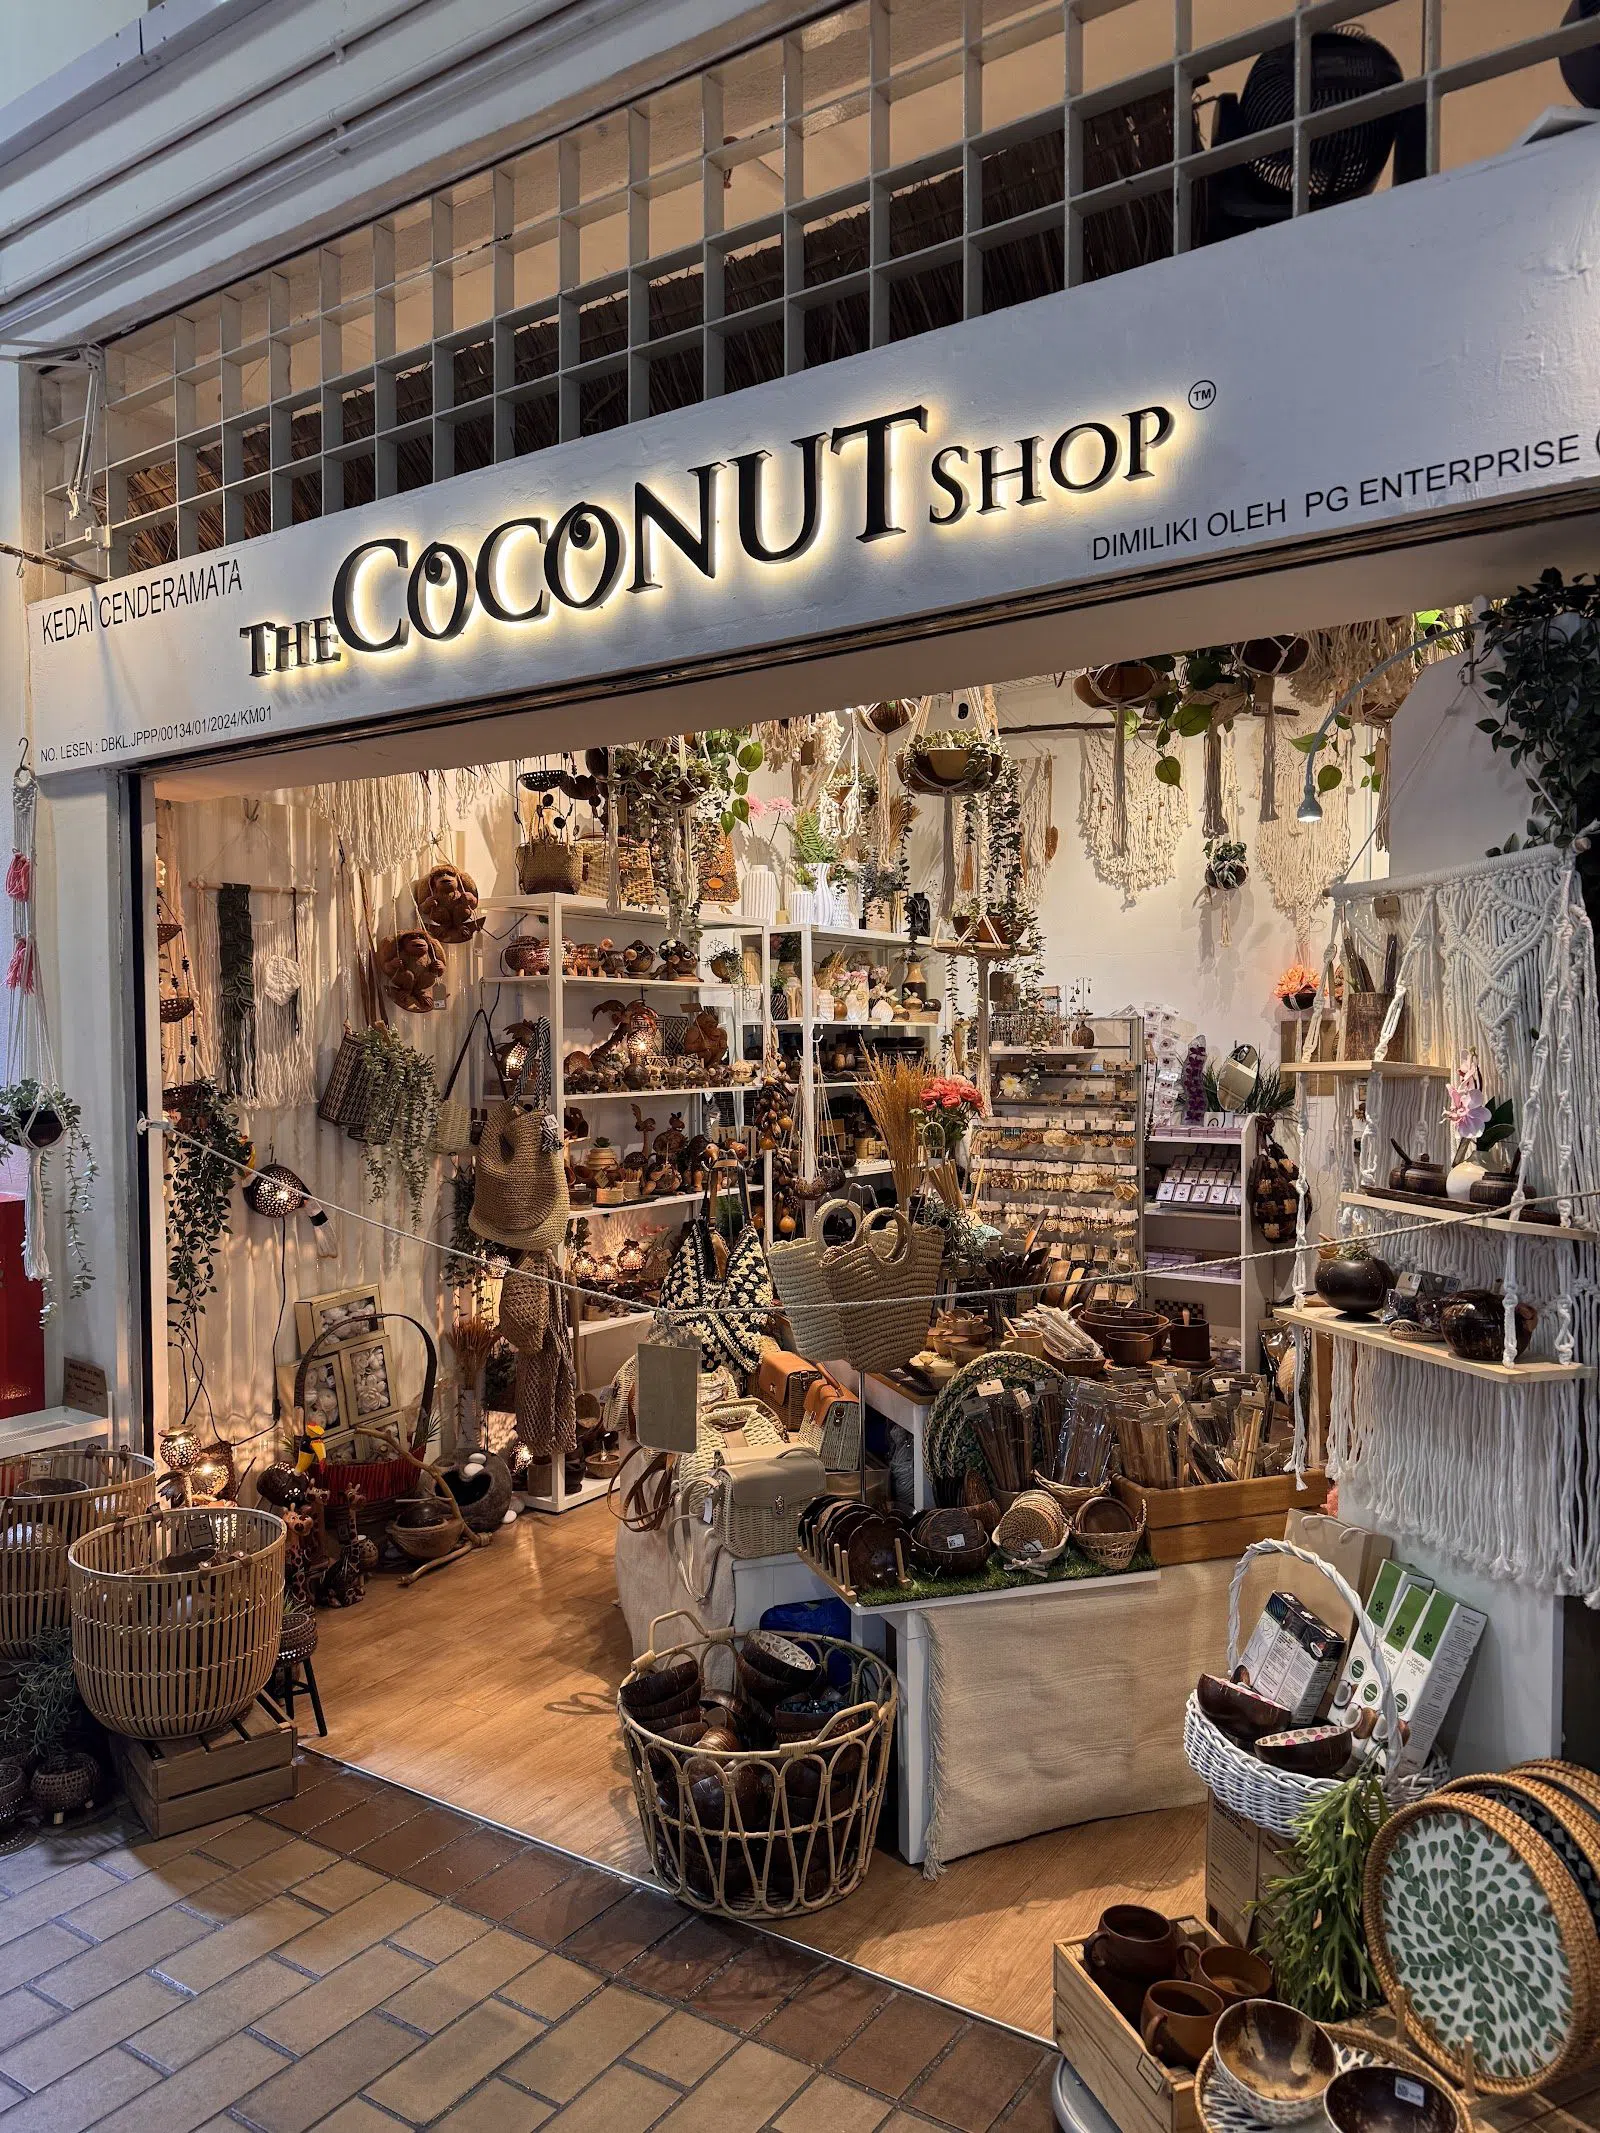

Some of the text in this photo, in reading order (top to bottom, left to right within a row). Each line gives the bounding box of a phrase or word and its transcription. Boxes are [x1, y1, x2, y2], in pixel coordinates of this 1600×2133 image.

[332, 404, 929, 653] COCONUT
[928, 404, 1174, 526] SHOP
[1093, 517, 1198, 561] DIMILIKI
[1207, 498, 1286, 538] OLEH
[1305, 485, 1349, 518] PG
[1359, 434, 1580, 507] ENTERPRISE
[42, 558, 243, 645] KEDAI CENDERAMATA
[40, 747, 58, 763] NO.
[60, 741, 94, 759] LESEN
[101, 705, 273, 753] DBKL.JPPP/00134/01/2024/KM01
